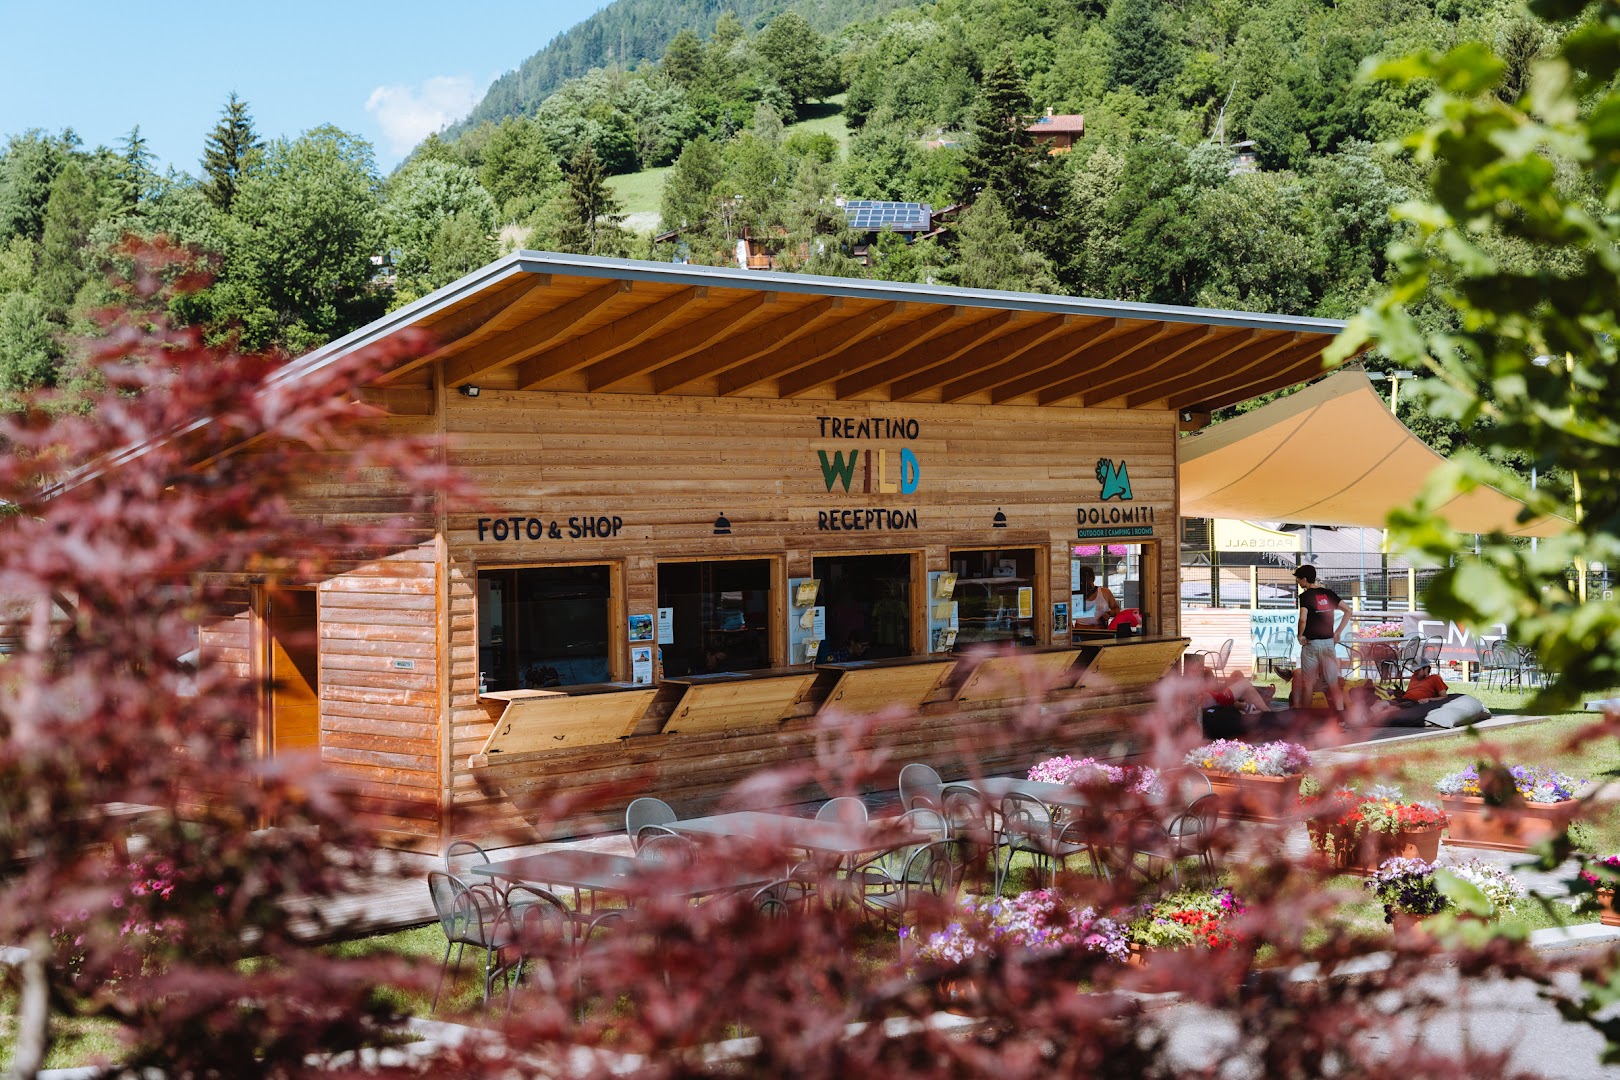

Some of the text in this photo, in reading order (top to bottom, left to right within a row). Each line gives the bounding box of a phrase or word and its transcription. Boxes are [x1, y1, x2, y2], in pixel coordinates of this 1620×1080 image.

[817, 416, 919, 440] TRENTINO
[817, 447, 920, 495] WILD
[818, 508, 918, 530] RECEPTION
[1077, 506, 1154, 524] DOLOMITI
[477, 516, 623, 541] FOTO & SHOP
[1078, 527, 1152, 537] OUTDOOR CAMPING ROOMS
[1251, 615, 1296, 624] RENTINO
